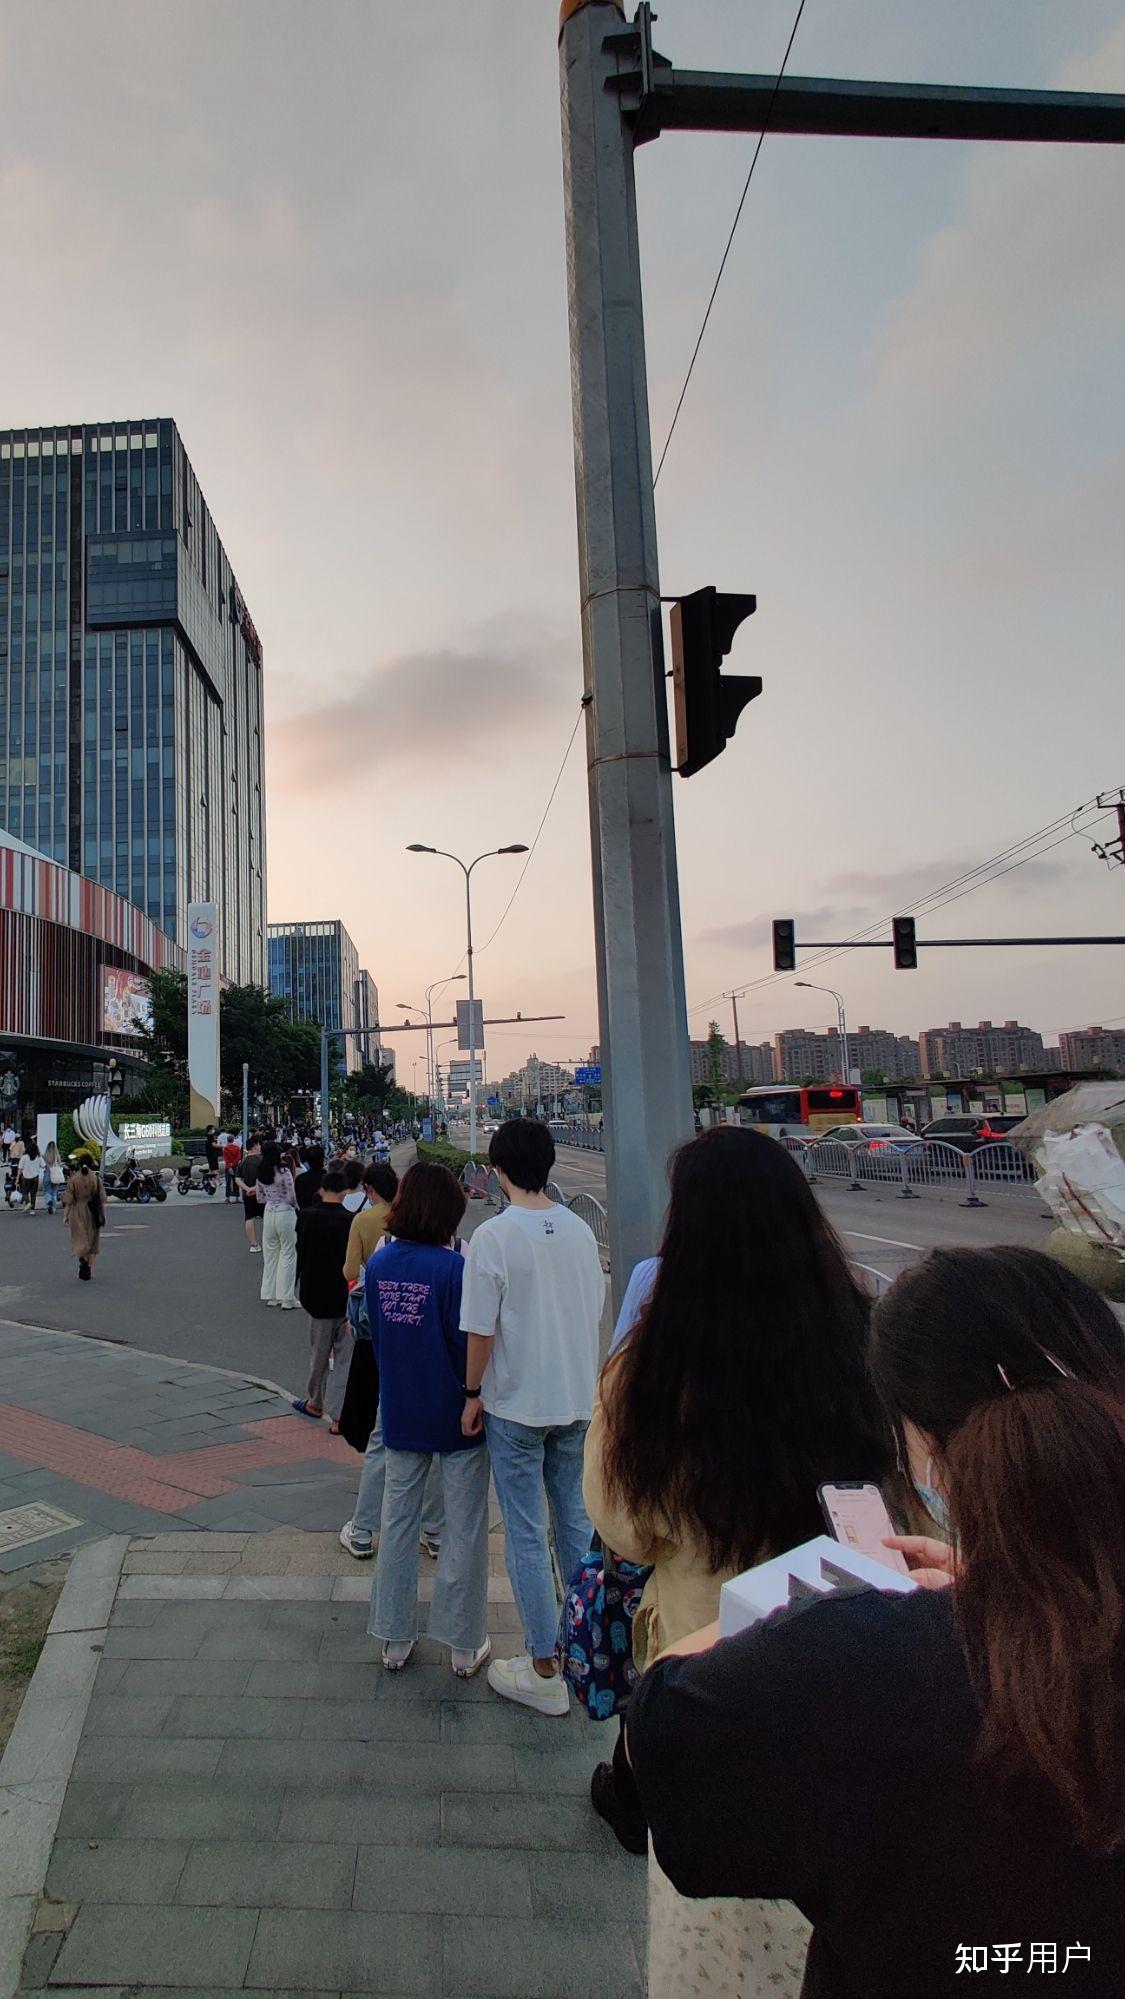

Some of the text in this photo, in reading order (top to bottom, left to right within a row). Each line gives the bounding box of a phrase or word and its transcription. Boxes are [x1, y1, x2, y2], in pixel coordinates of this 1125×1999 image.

[47, 1080, 81, 1088] STARBUCKS
[379, 1291, 401, 1301] DONE
[381, 1301, 419, 1314] GOT THE
